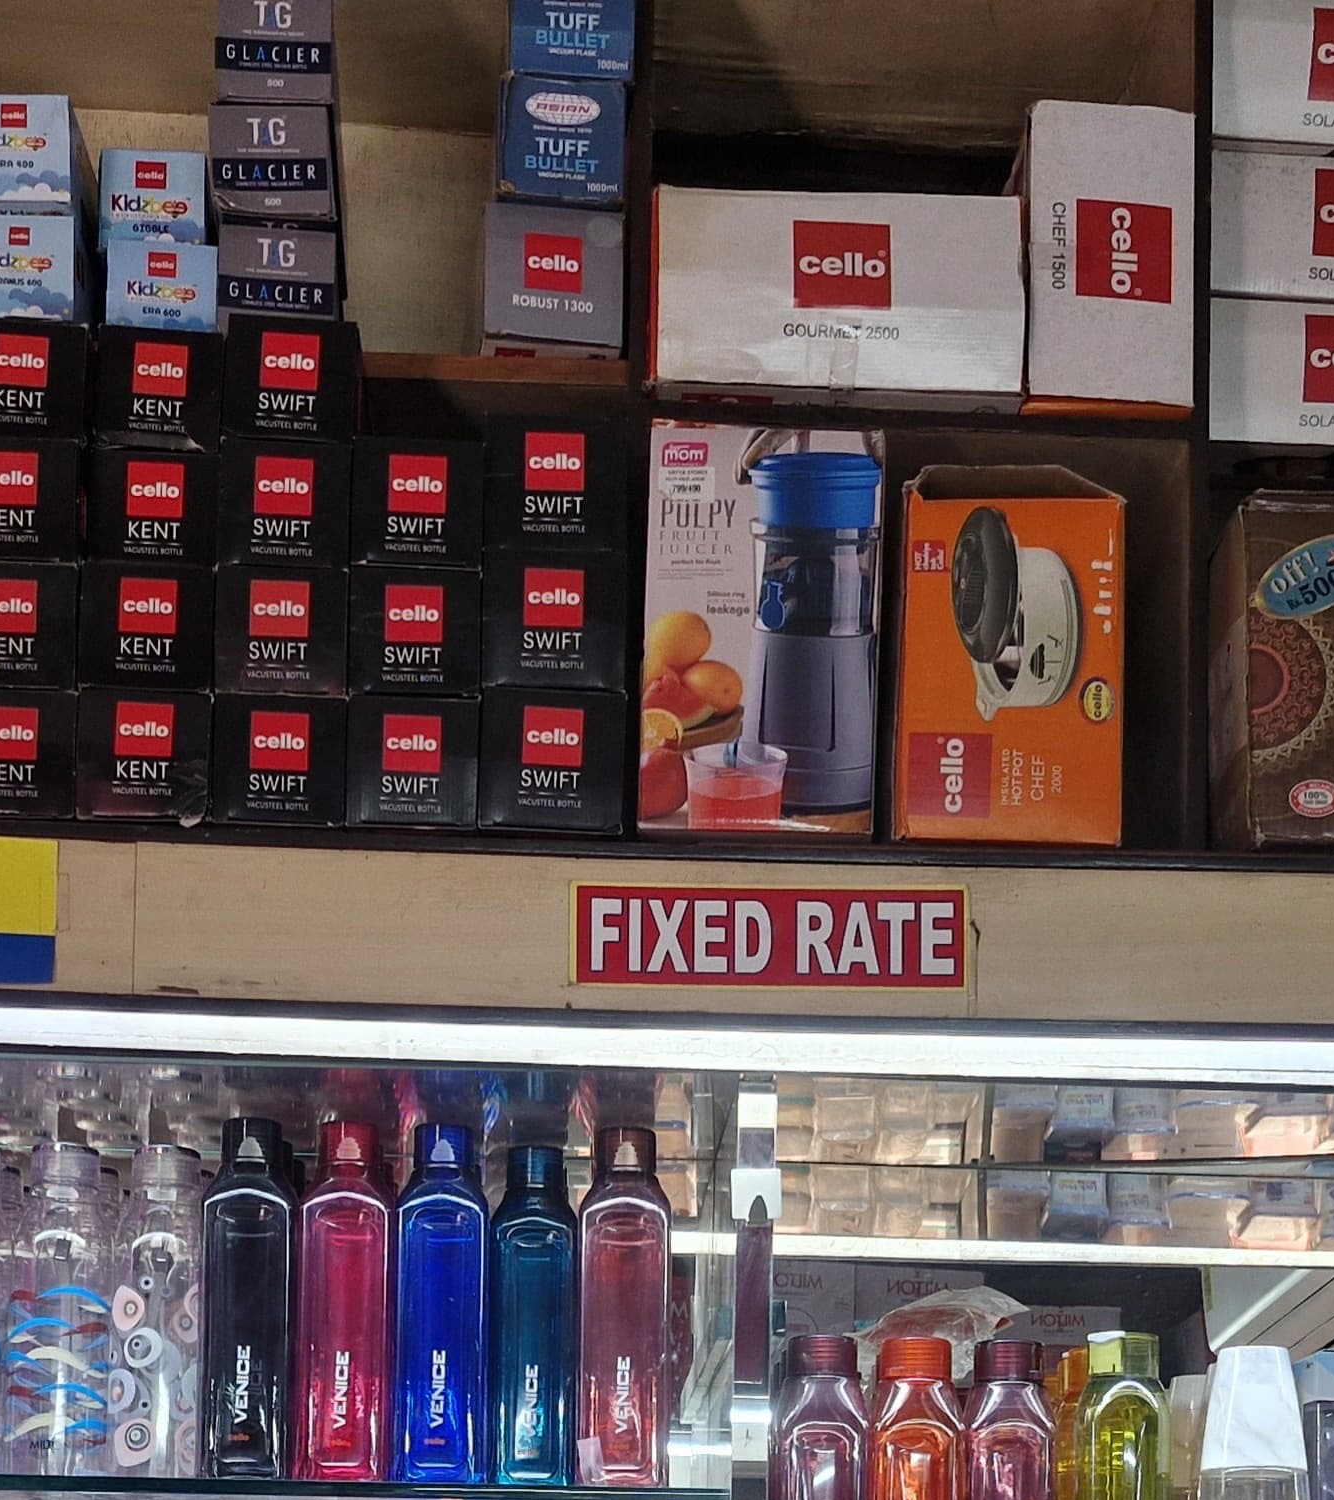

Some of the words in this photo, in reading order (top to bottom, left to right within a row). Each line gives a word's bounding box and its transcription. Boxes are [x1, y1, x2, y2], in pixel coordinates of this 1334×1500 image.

[226, 43, 321, 64] GLACIER
[535, 103, 591, 115] ASIAN
[535, 136, 590, 157] TUFF
[222, 163, 317, 181] GLACIER
[524, 155, 598, 175] BULLET
[587, 182, 618, 194] 1000ml
[1051, 201, 1066, 246] CHEF
[1111, 207, 1138, 295] cello
[527, 254, 579, 273] cello
[799, 251, 886, 279] cello
[1051, 249, 1065, 290] 1500
[512, 293, 560, 311] ROBUST
[563, 299, 594, 314] 1300
[783, 323, 862, 340] GOURMET
[865, 324, 900, 341] 2500
[264, 354, 316, 371] cello
[258, 393, 316, 413] SWIFT
[528, 453, 581, 471] cello
[524, 495, 584, 514] SWIFT
[660, 499, 736, 529] PULPY
[659, 530, 721, 541] FRUIT
[659, 543, 733, 555] JUICER
[1269, 550, 1321, 594] off!
[116, 760, 170, 779] KENT
[941, 738, 964, 814] cello
[1001, 748, 1010, 806] INSULATED
[1030, 755, 1045, 802] CHEF
[1050, 764, 1062, 793] 2000
[381, 775, 439, 795] SWIFT
[589, 896, 774, 975] FIXED
[794, 899, 956, 976] RATE
[231, 1344, 251, 1425] VENICE
[331, 1350, 350, 1430] VENICE
